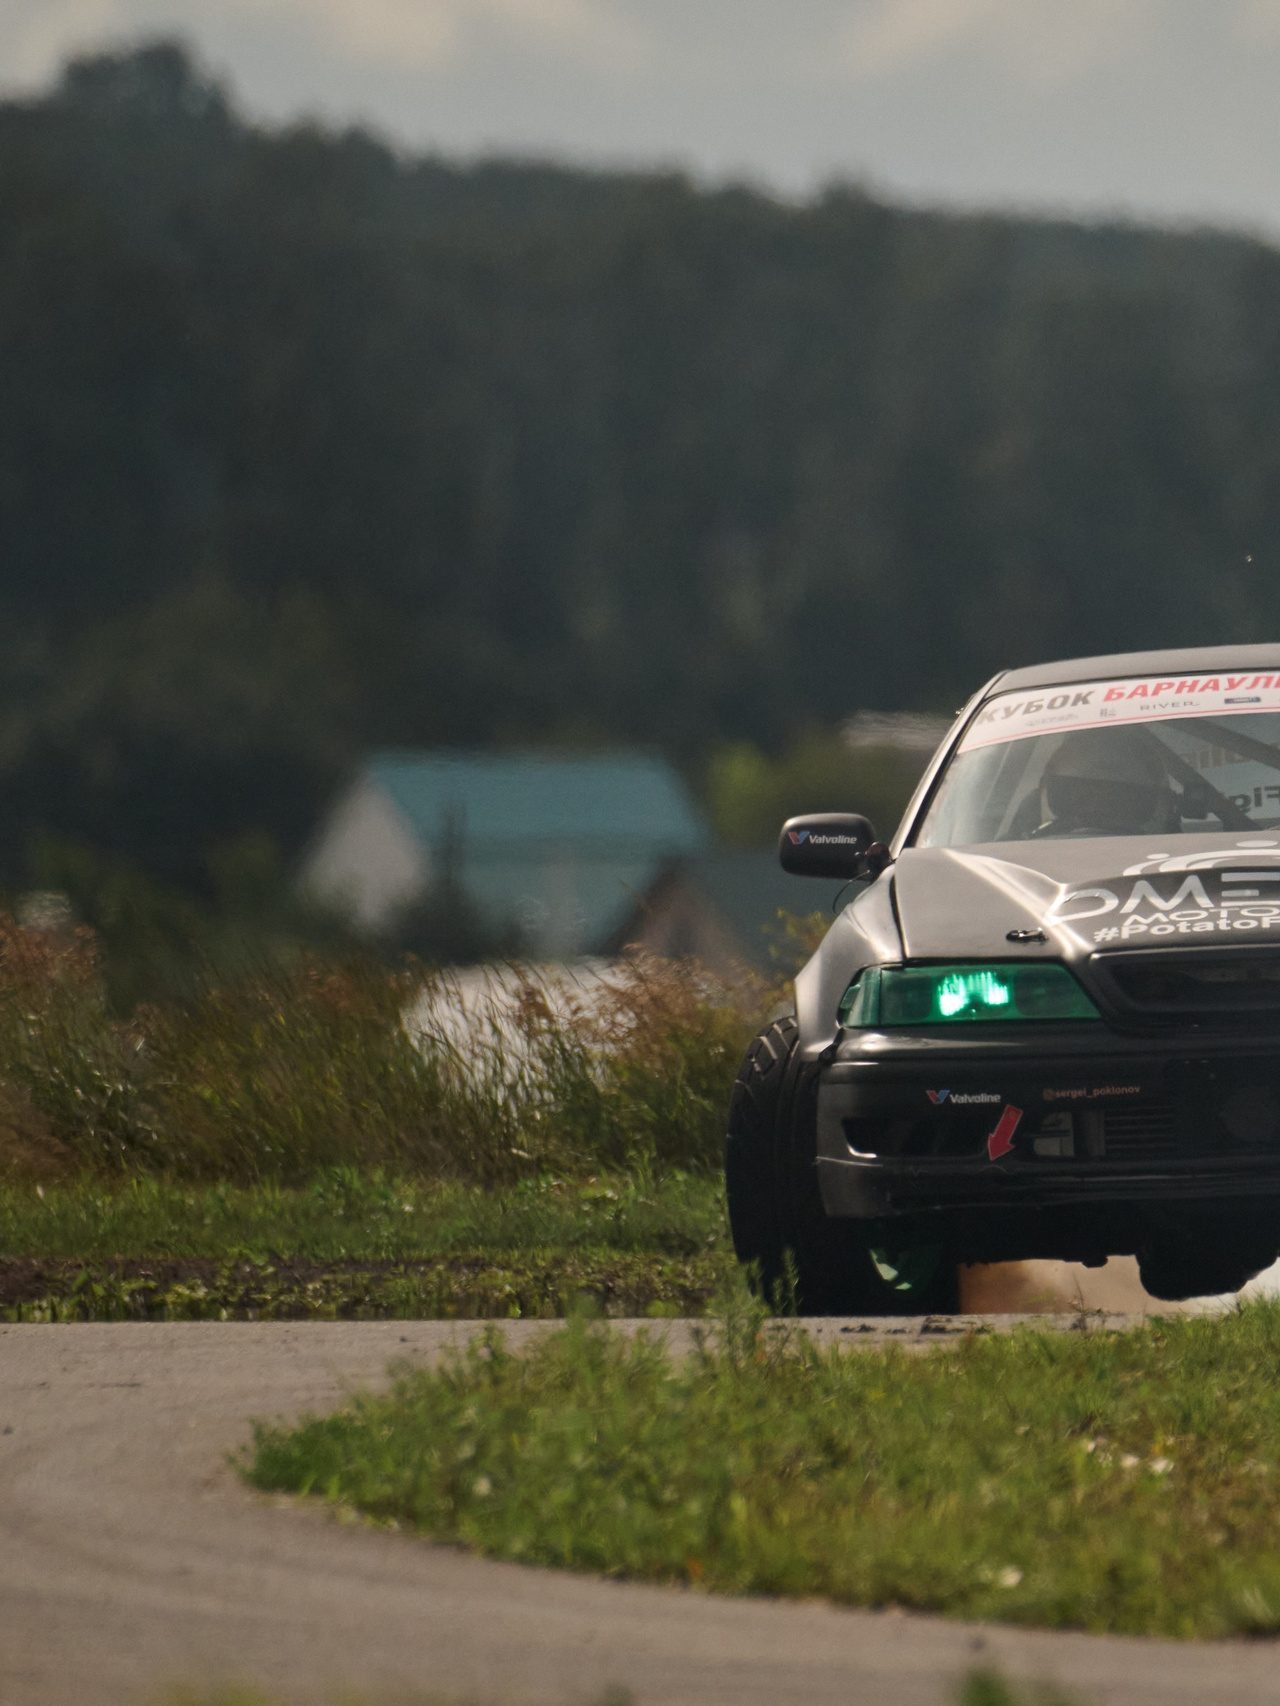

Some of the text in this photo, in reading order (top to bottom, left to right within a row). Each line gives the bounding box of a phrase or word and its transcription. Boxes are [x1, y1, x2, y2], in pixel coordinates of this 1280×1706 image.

[977, 690, 1095, 724] КУБОК
[808, 834, 858, 845] Valvoline
[949, 1092, 1001, 1104] Valvoline
